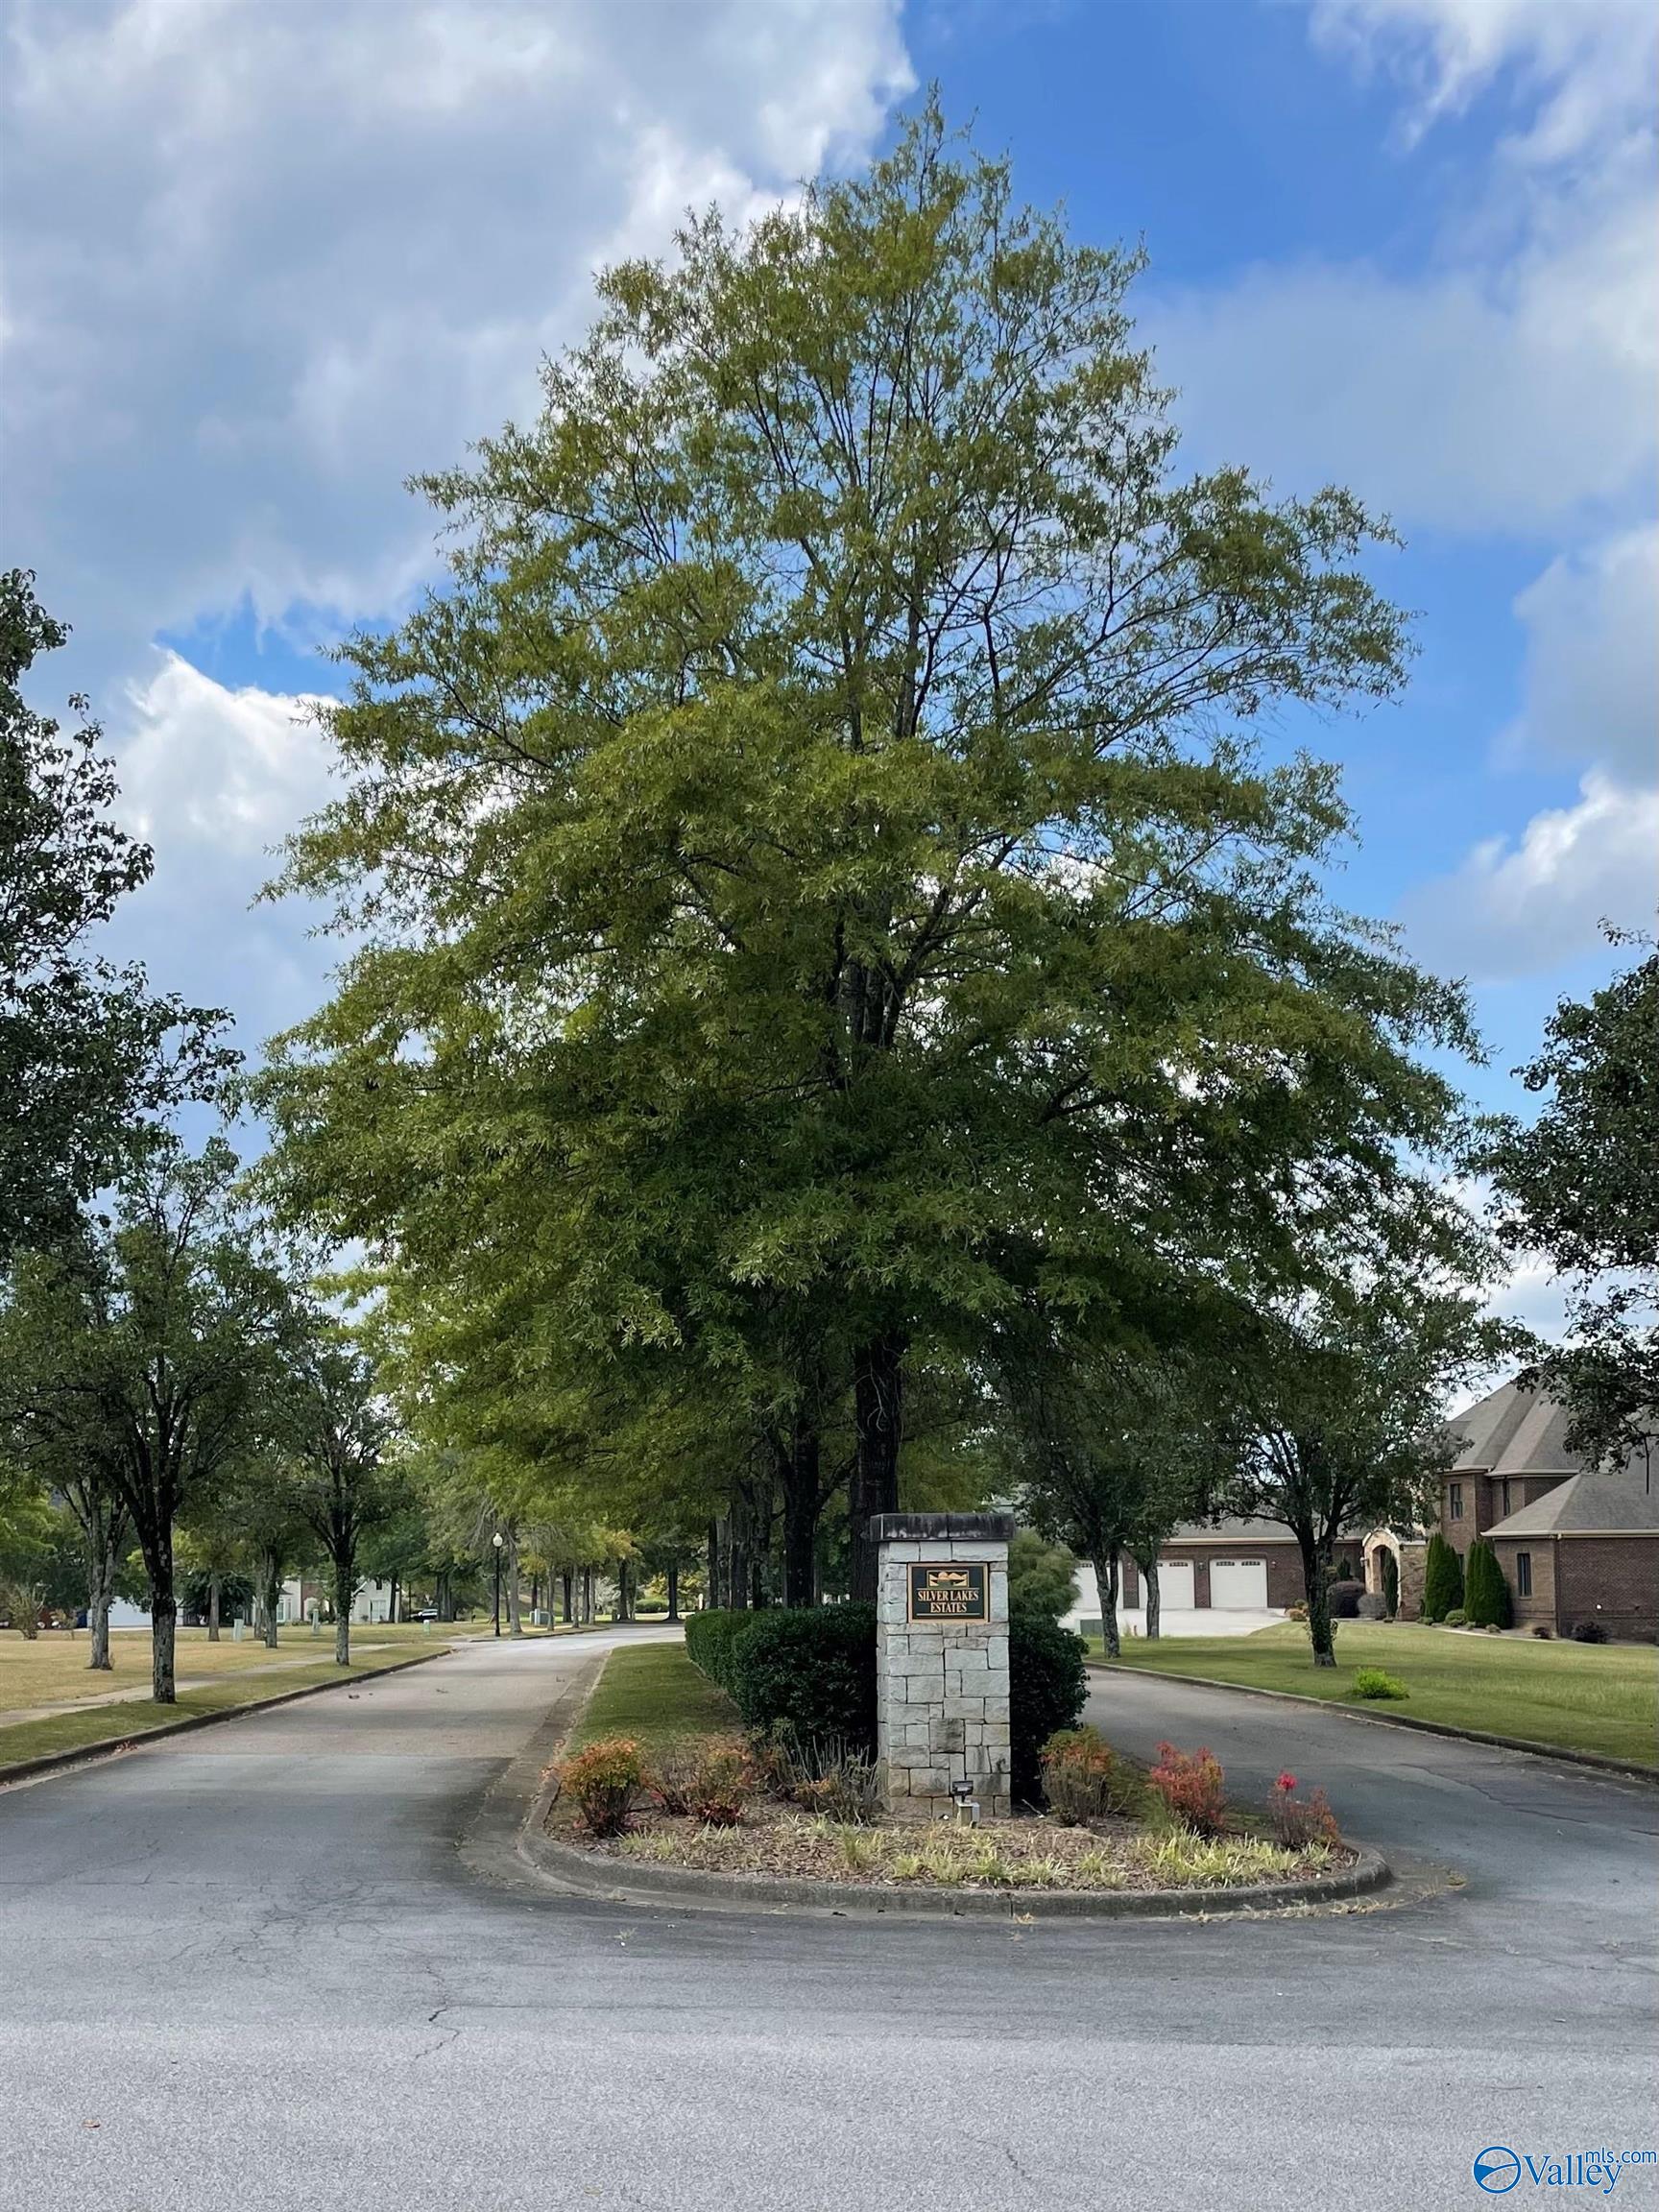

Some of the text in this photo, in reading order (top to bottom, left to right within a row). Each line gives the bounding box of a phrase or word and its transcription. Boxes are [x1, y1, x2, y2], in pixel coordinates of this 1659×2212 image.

[918, 1590, 979, 1601] SILVER LAKES
[930, 1602, 967, 1613] ESTATES
